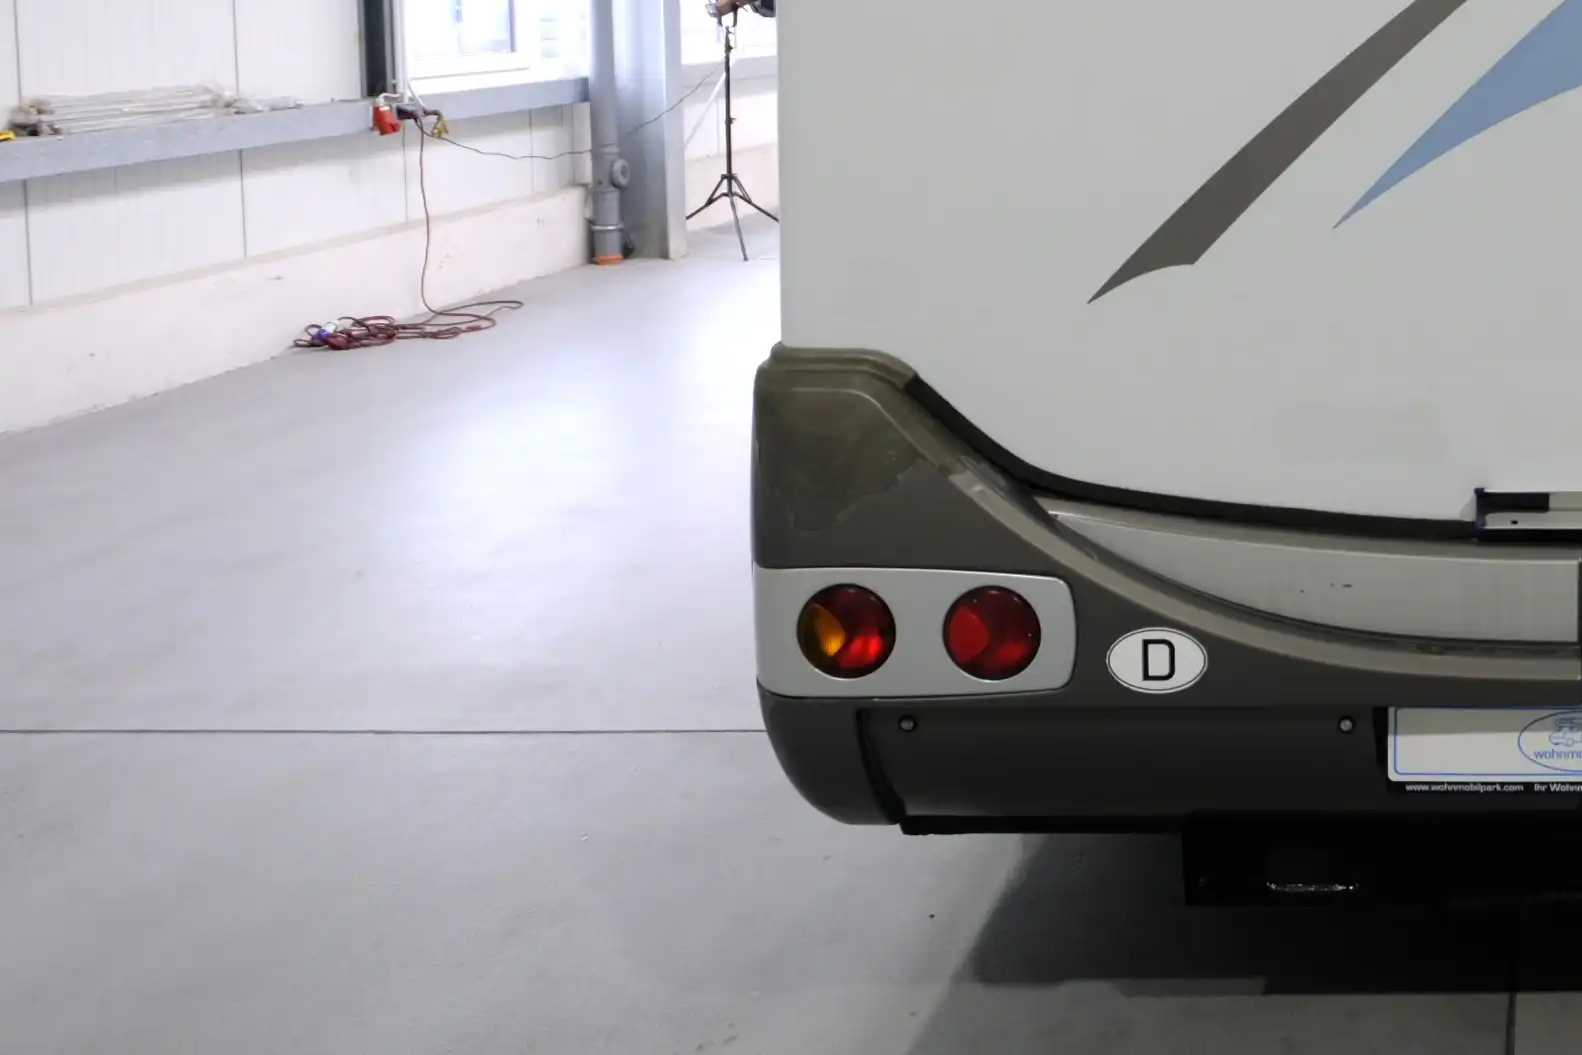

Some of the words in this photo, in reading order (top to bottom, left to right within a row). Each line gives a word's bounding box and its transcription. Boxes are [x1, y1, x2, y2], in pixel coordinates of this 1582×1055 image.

[1142, 639, 1176, 681] D
[1405, 783, 1524, 793] www.wohnmobilpark.com
[1534, 783, 1546, 792] Ihr
